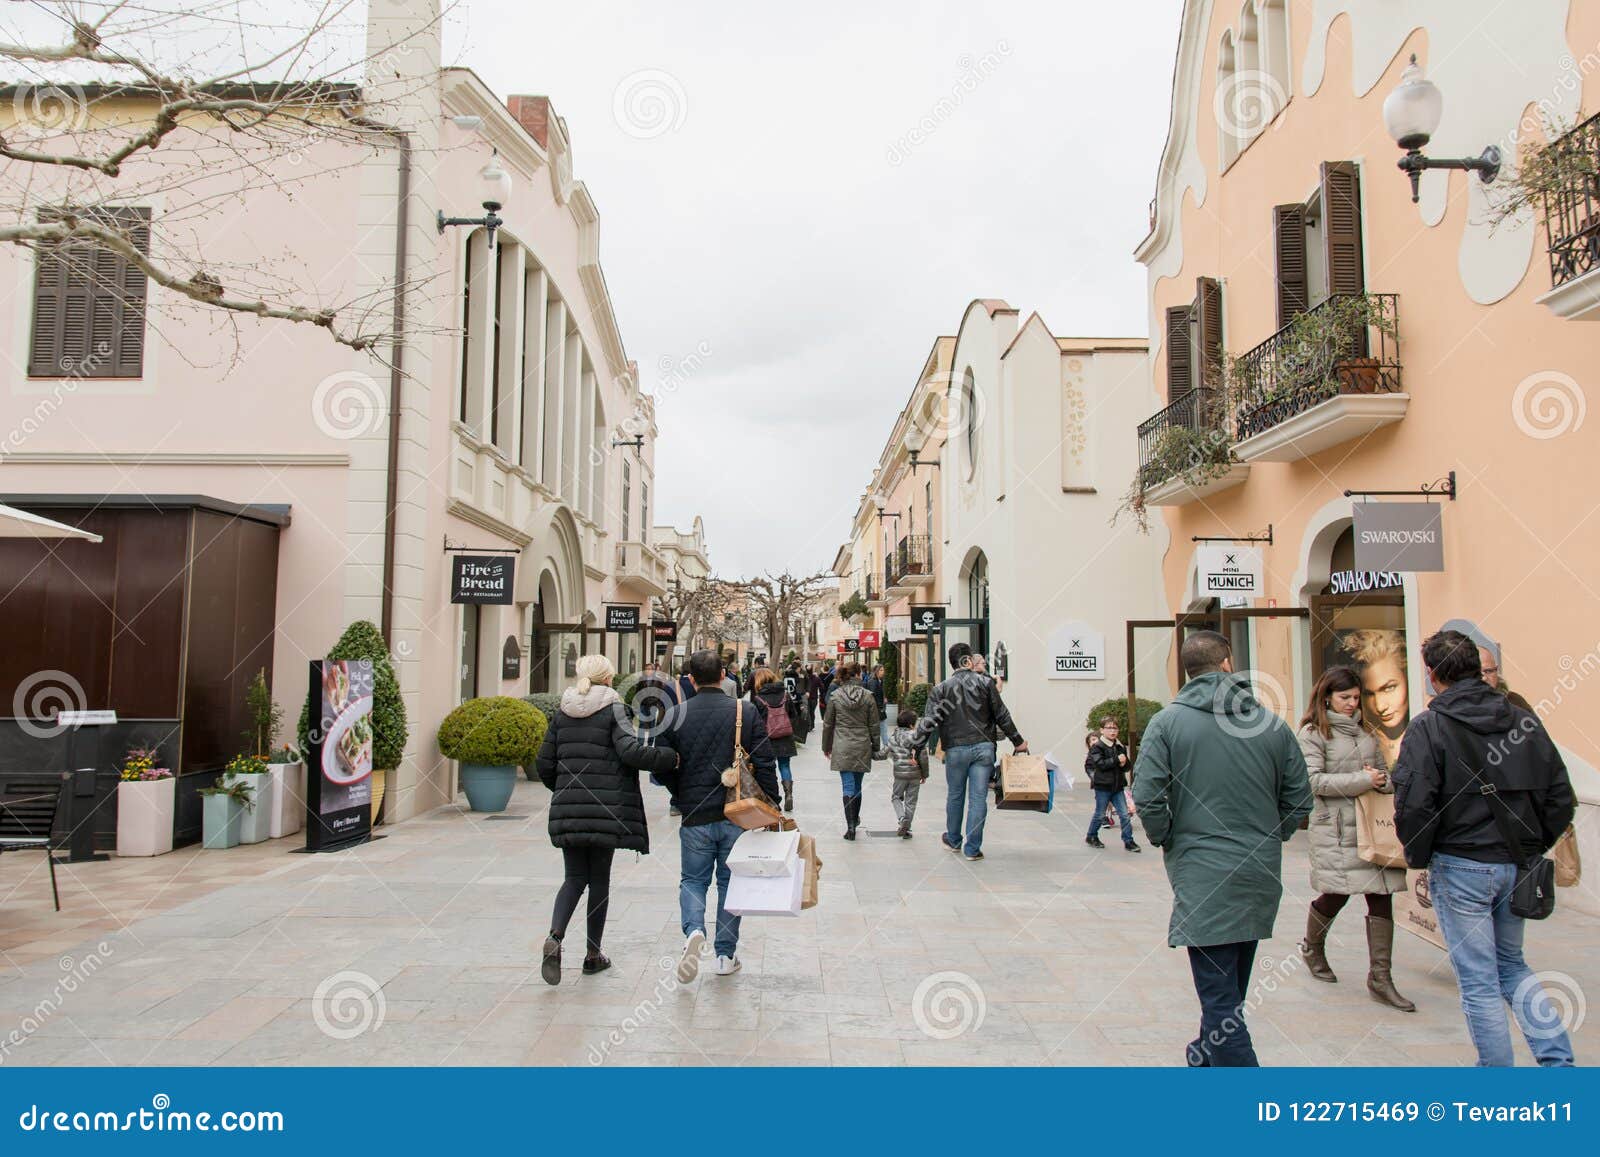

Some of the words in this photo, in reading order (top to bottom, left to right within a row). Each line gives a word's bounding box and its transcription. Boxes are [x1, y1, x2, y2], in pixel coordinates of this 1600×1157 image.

[1361, 530, 1435, 544] SWAROVSKI
[461, 563, 491, 576] Fire
[460, 577, 504, 589] Bread
[1208, 576, 1254, 588] MUNICH
[1056, 659, 1097, 669] MUNICH
